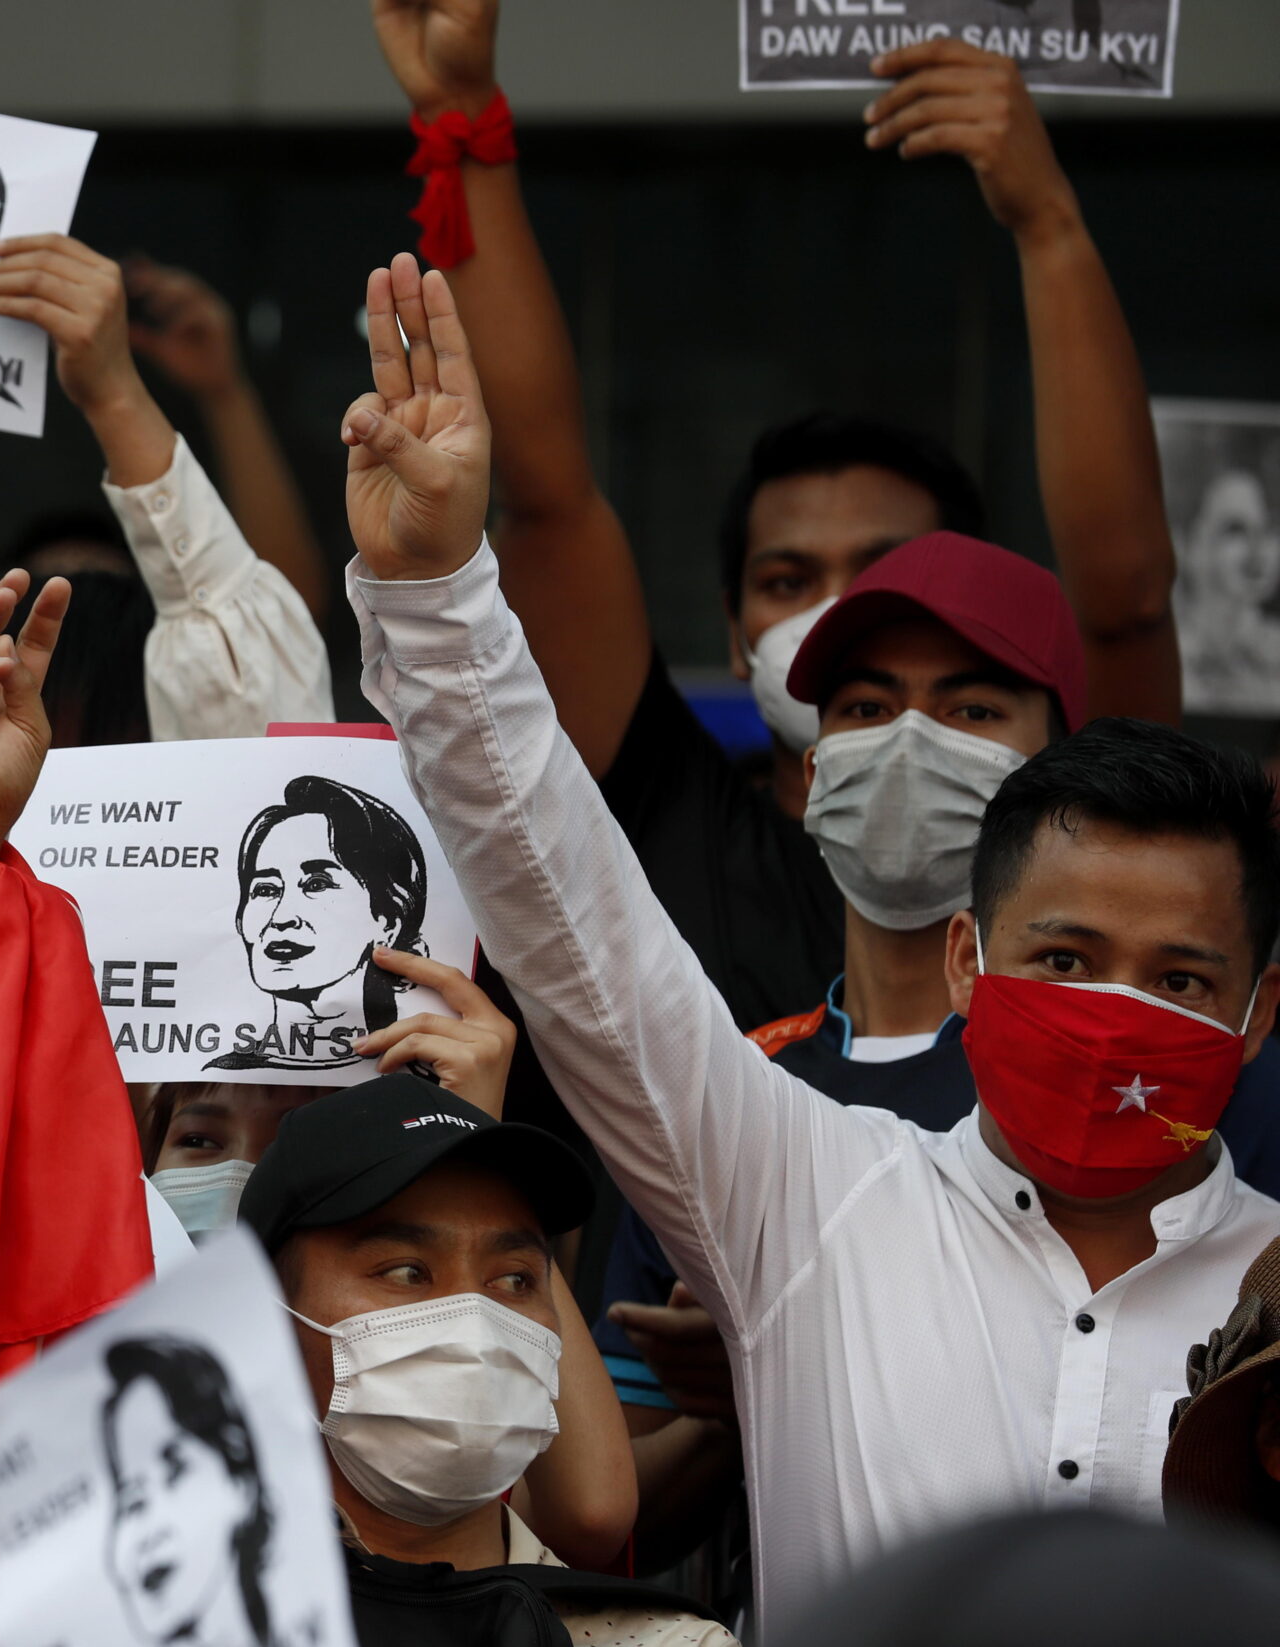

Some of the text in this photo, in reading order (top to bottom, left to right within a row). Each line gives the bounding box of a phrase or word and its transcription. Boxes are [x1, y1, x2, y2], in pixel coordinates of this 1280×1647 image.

[761, 25, 842, 57] DAW
[961, 24, 1031, 59] SAN
[1040, 28, 1090, 61] SU
[1100, 32, 1159, 64] KYI
[49, 800, 183, 825] WE WANT
[39, 846, 219, 868] OUR LEADER
[90, 960, 178, 1008] EE
[114, 1022, 367, 1058] AUNG SAN S
[401, 1113, 478, 1131] SPIRIT
